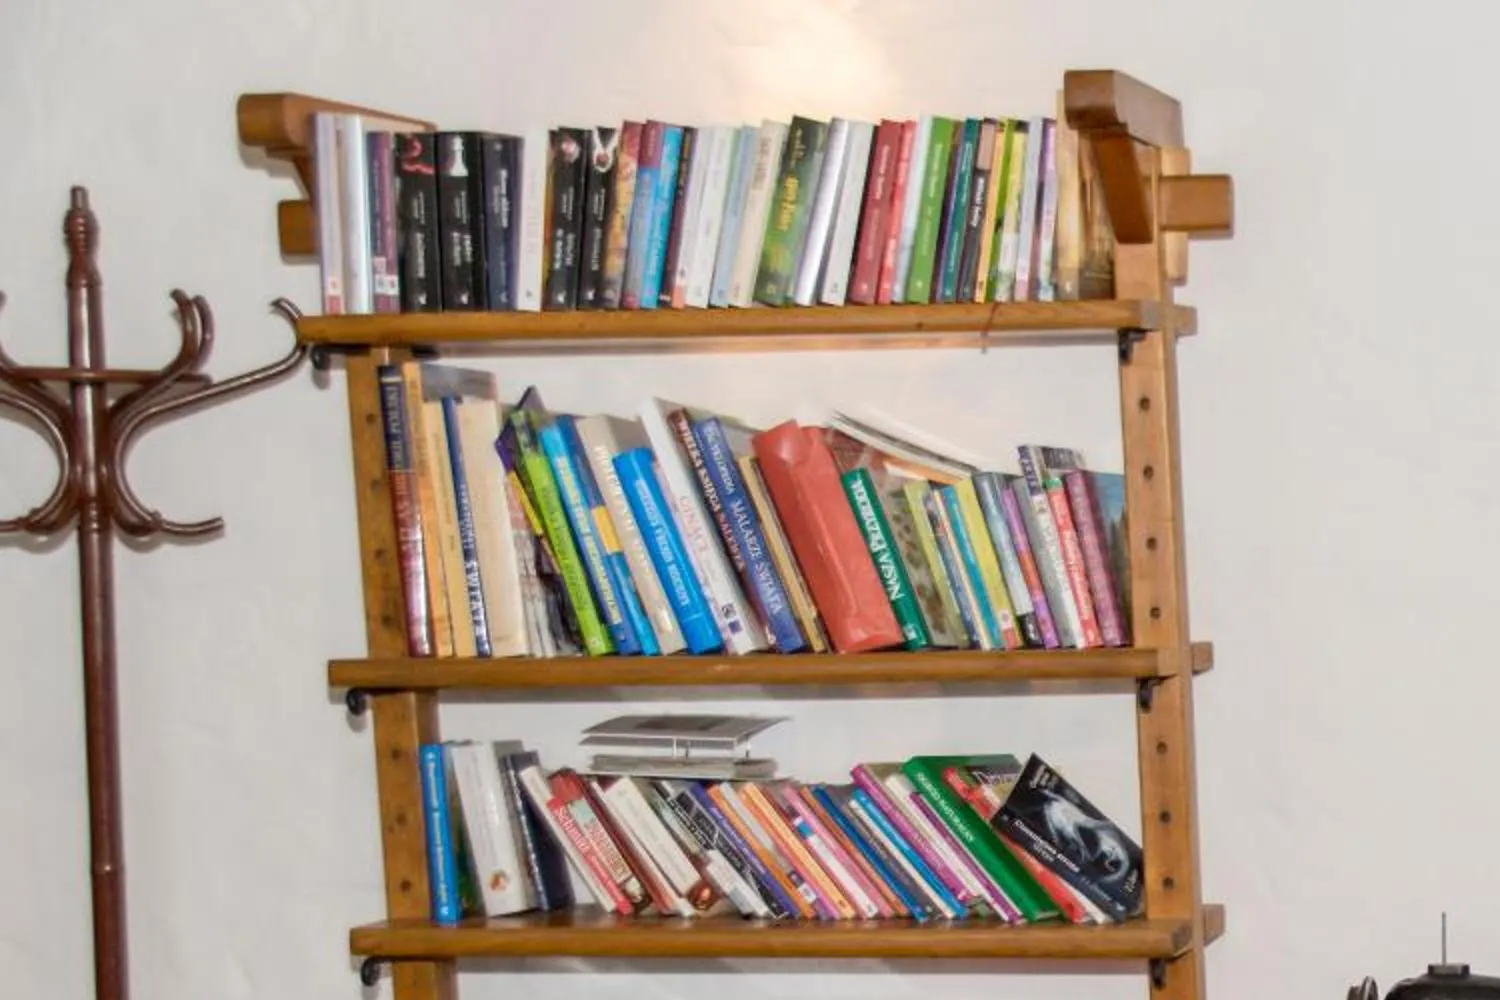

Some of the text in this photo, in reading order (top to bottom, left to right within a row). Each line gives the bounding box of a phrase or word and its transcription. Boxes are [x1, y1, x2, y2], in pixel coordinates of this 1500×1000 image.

[728, 499, 763, 559] MALARZE
[849, 478, 905, 602] NASZA PRZYRODA
